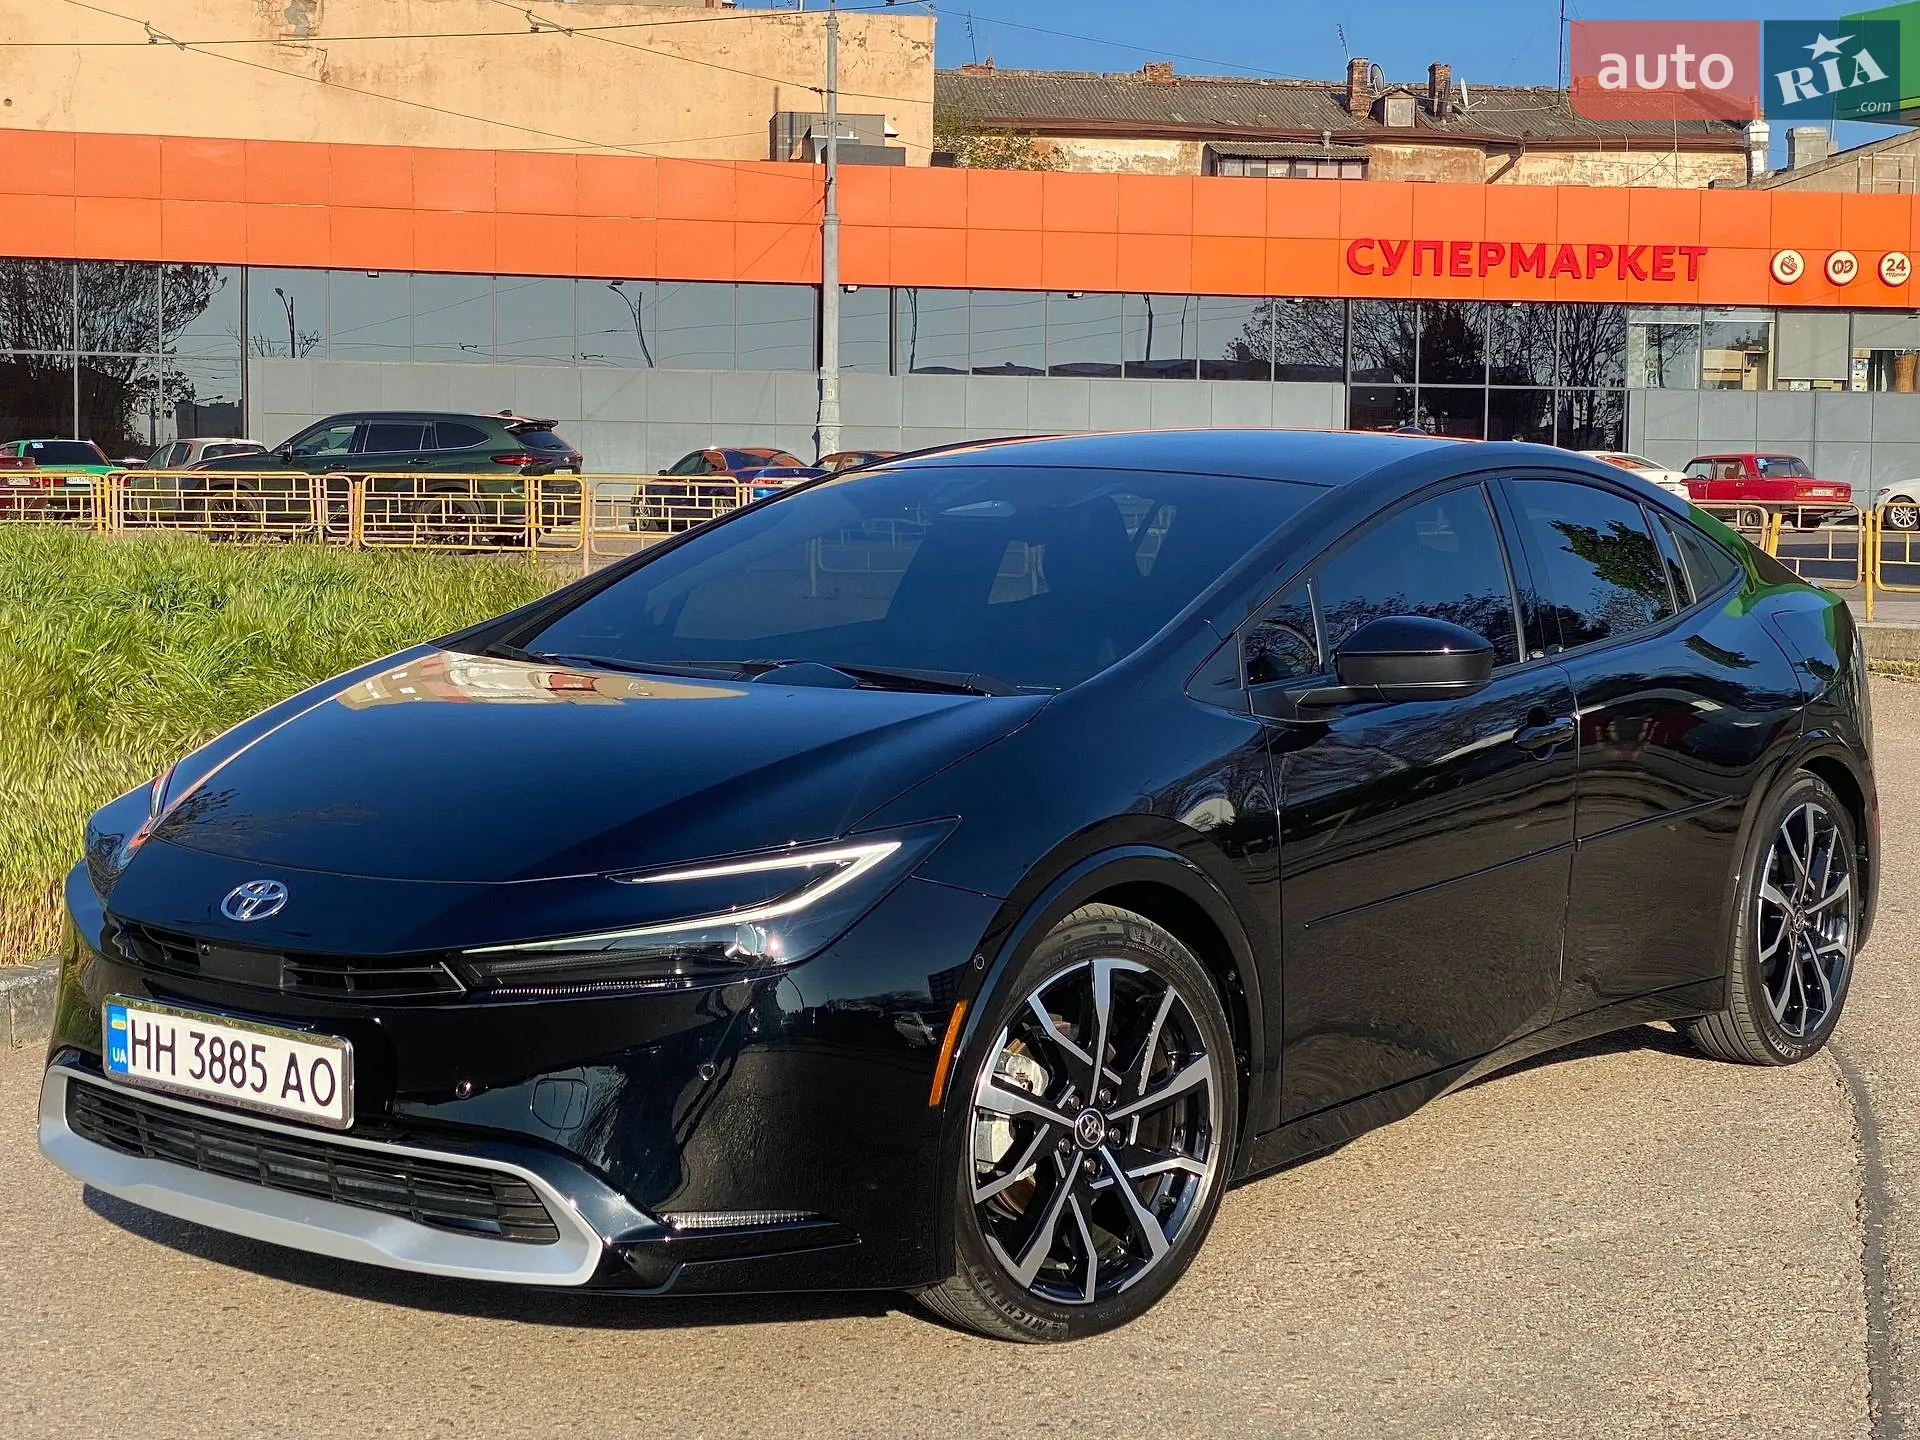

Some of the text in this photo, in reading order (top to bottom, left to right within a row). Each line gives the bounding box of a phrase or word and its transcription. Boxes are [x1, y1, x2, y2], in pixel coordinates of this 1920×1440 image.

[1346, 237, 1709, 282] СУПЕРМАРКЕТ
[1886, 258, 1906, 272] 24
[112, 1046, 127, 1064] UA
[131, 1019, 336, 1107] HH 3885 AO
[973, 1269, 1046, 1332] MICHELIN
